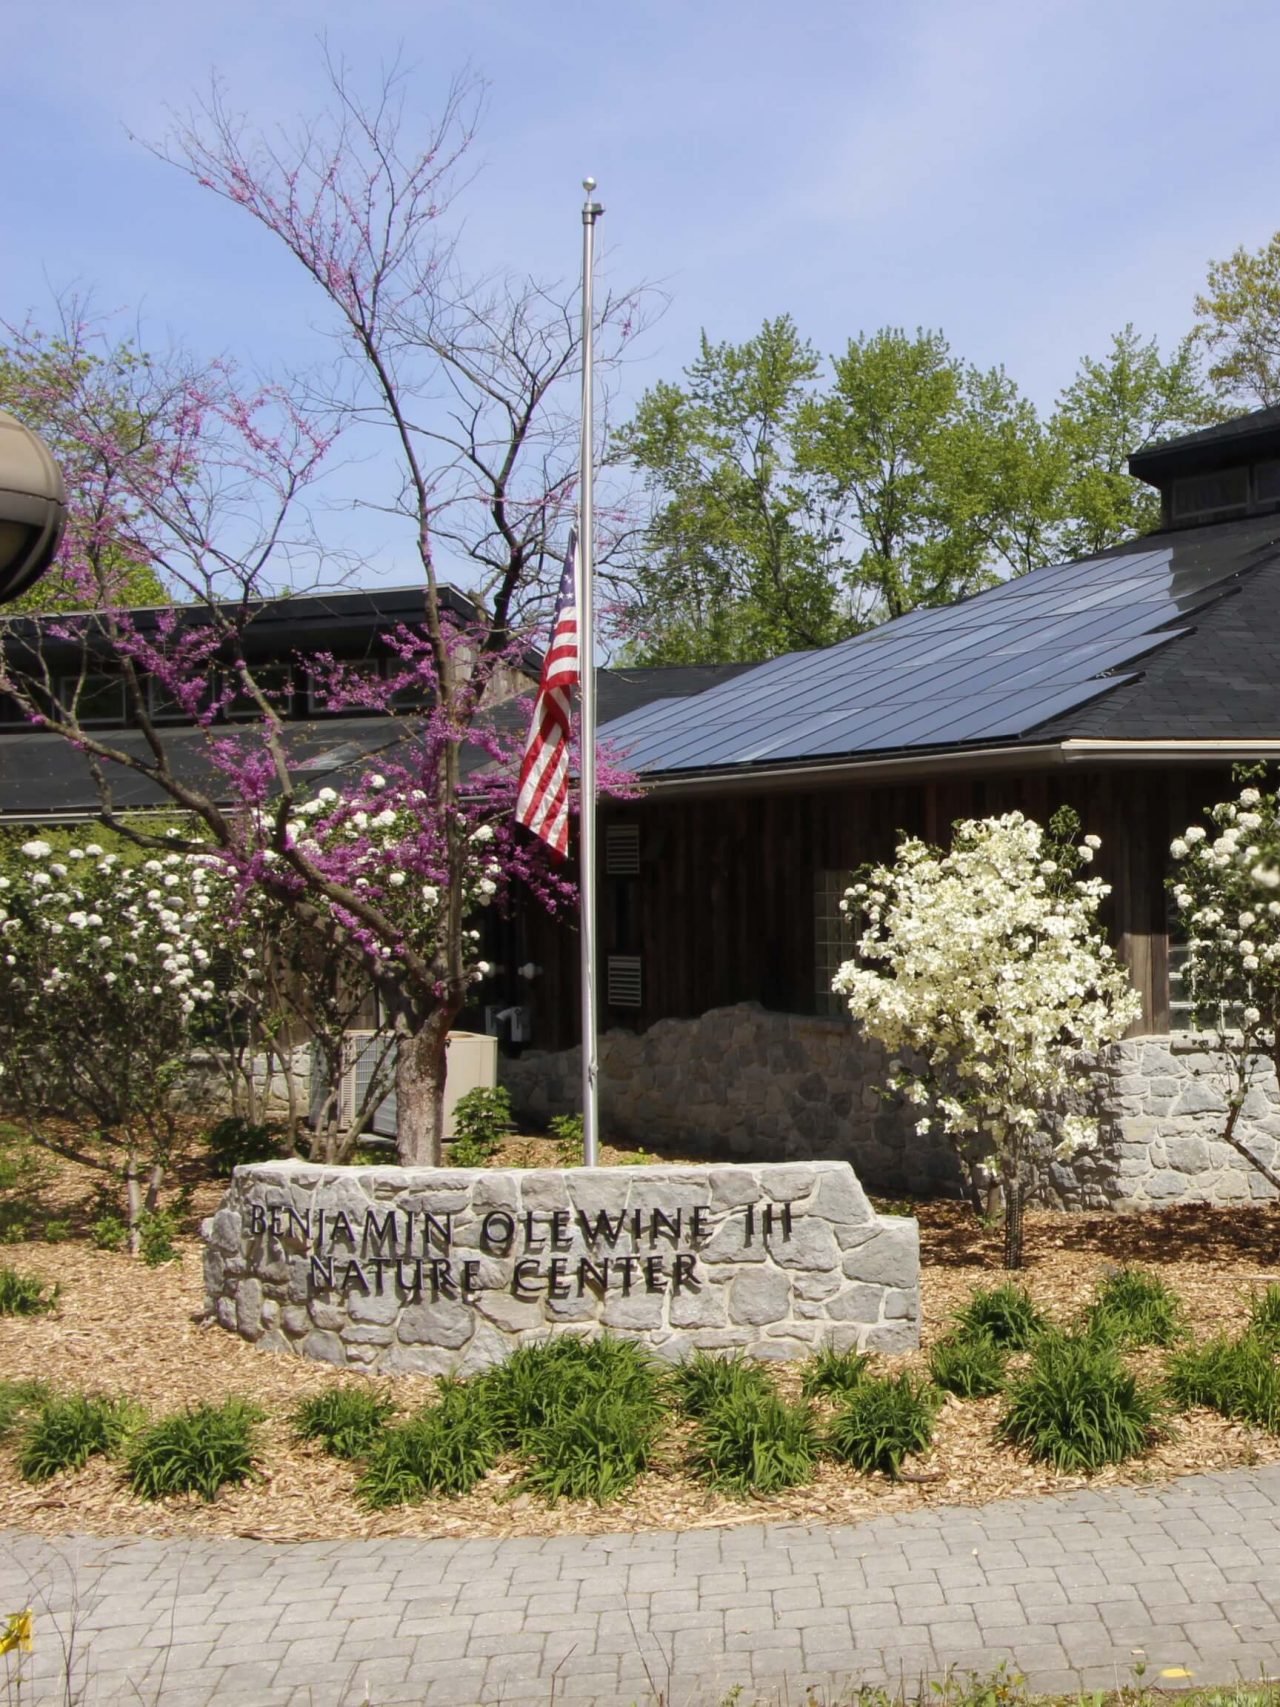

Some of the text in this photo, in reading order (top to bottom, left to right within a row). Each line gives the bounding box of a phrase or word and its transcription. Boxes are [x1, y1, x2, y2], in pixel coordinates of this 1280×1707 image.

[251, 1202, 792, 1248] BENJAMIN OLEWINE III
[310, 1253, 701, 1291] NATURE CENTER
